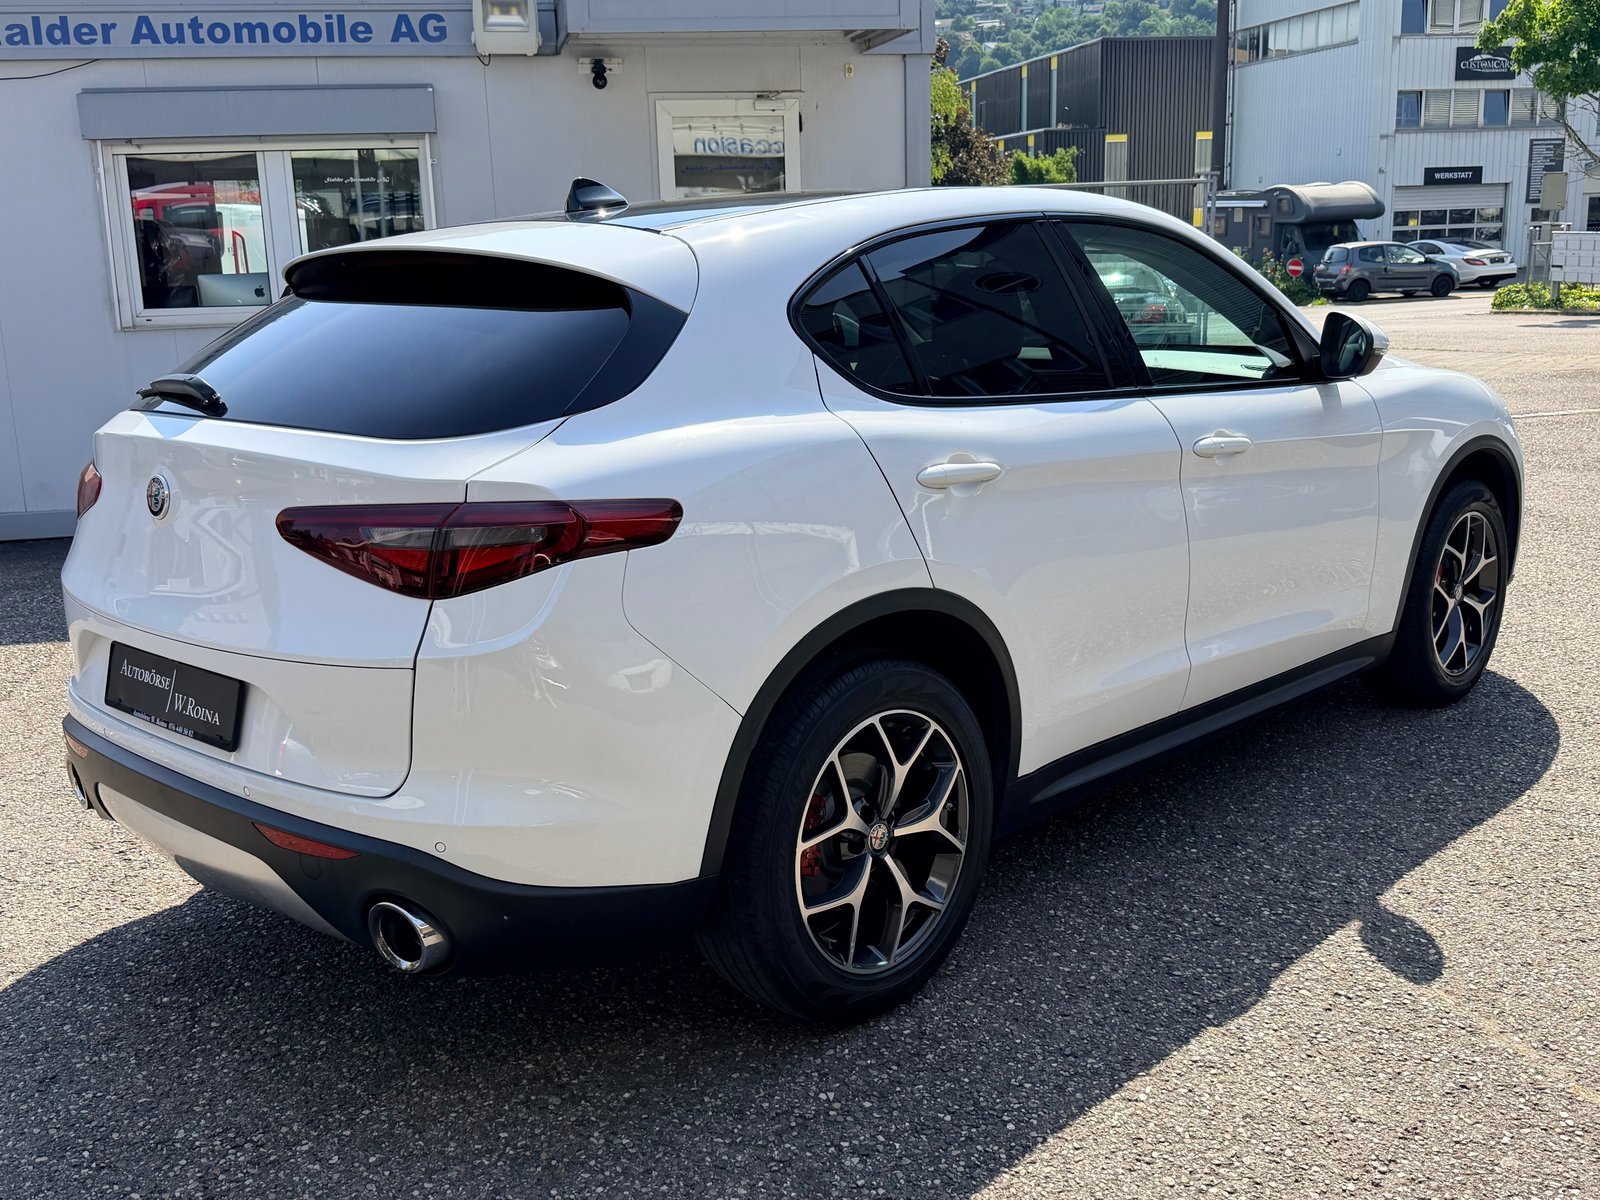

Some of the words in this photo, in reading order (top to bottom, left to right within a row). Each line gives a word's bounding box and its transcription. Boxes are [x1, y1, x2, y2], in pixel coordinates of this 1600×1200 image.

[0, 15, 117, 46] alder
[130, 14, 373, 45] Automobile
[390, 13, 448, 43] AG
[1434, 171, 1473, 180] WERKSTATT
